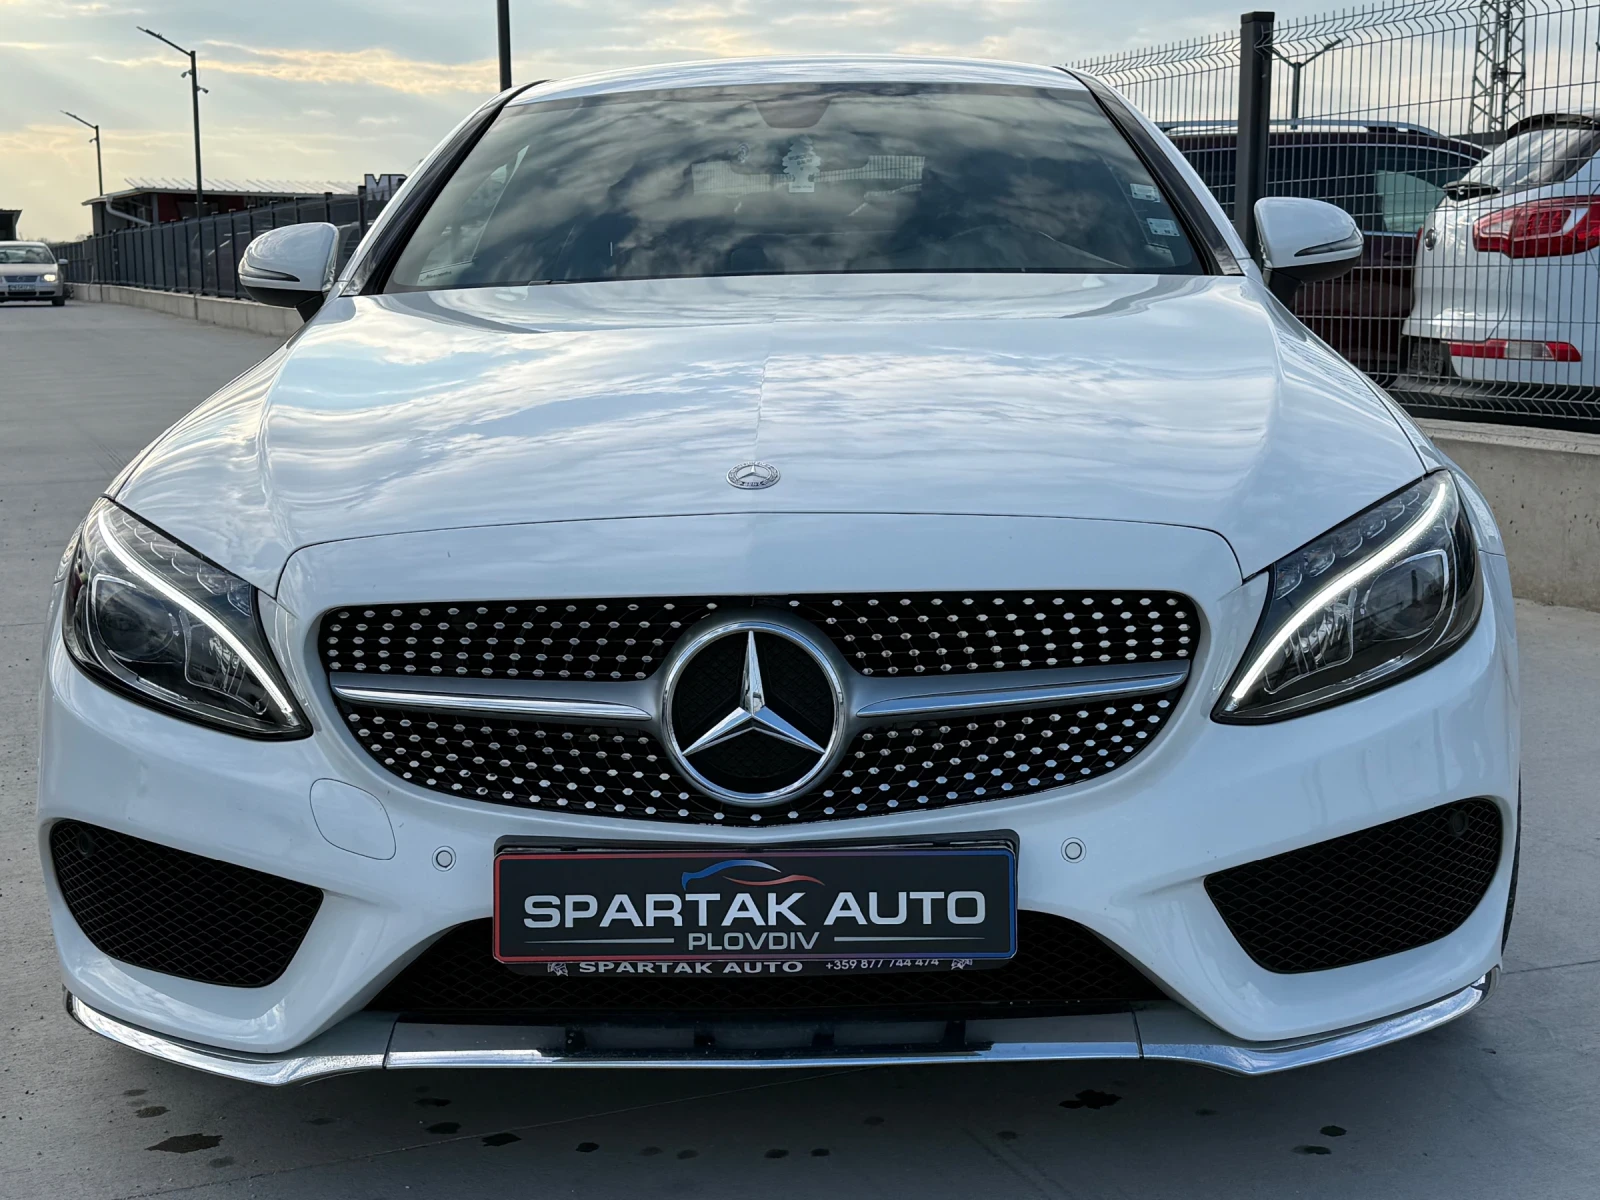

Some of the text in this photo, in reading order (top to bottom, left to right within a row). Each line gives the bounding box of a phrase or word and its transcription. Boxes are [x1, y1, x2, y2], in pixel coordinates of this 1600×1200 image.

[523, 890, 986, 929] SPARTAK AUTO
[688, 931, 820, 950] PLOVDIV
[579, 961, 803, 974] SPARTAK AUTO
[826, 959, 857, 970] +359
[860, 959, 883, 969] 877
